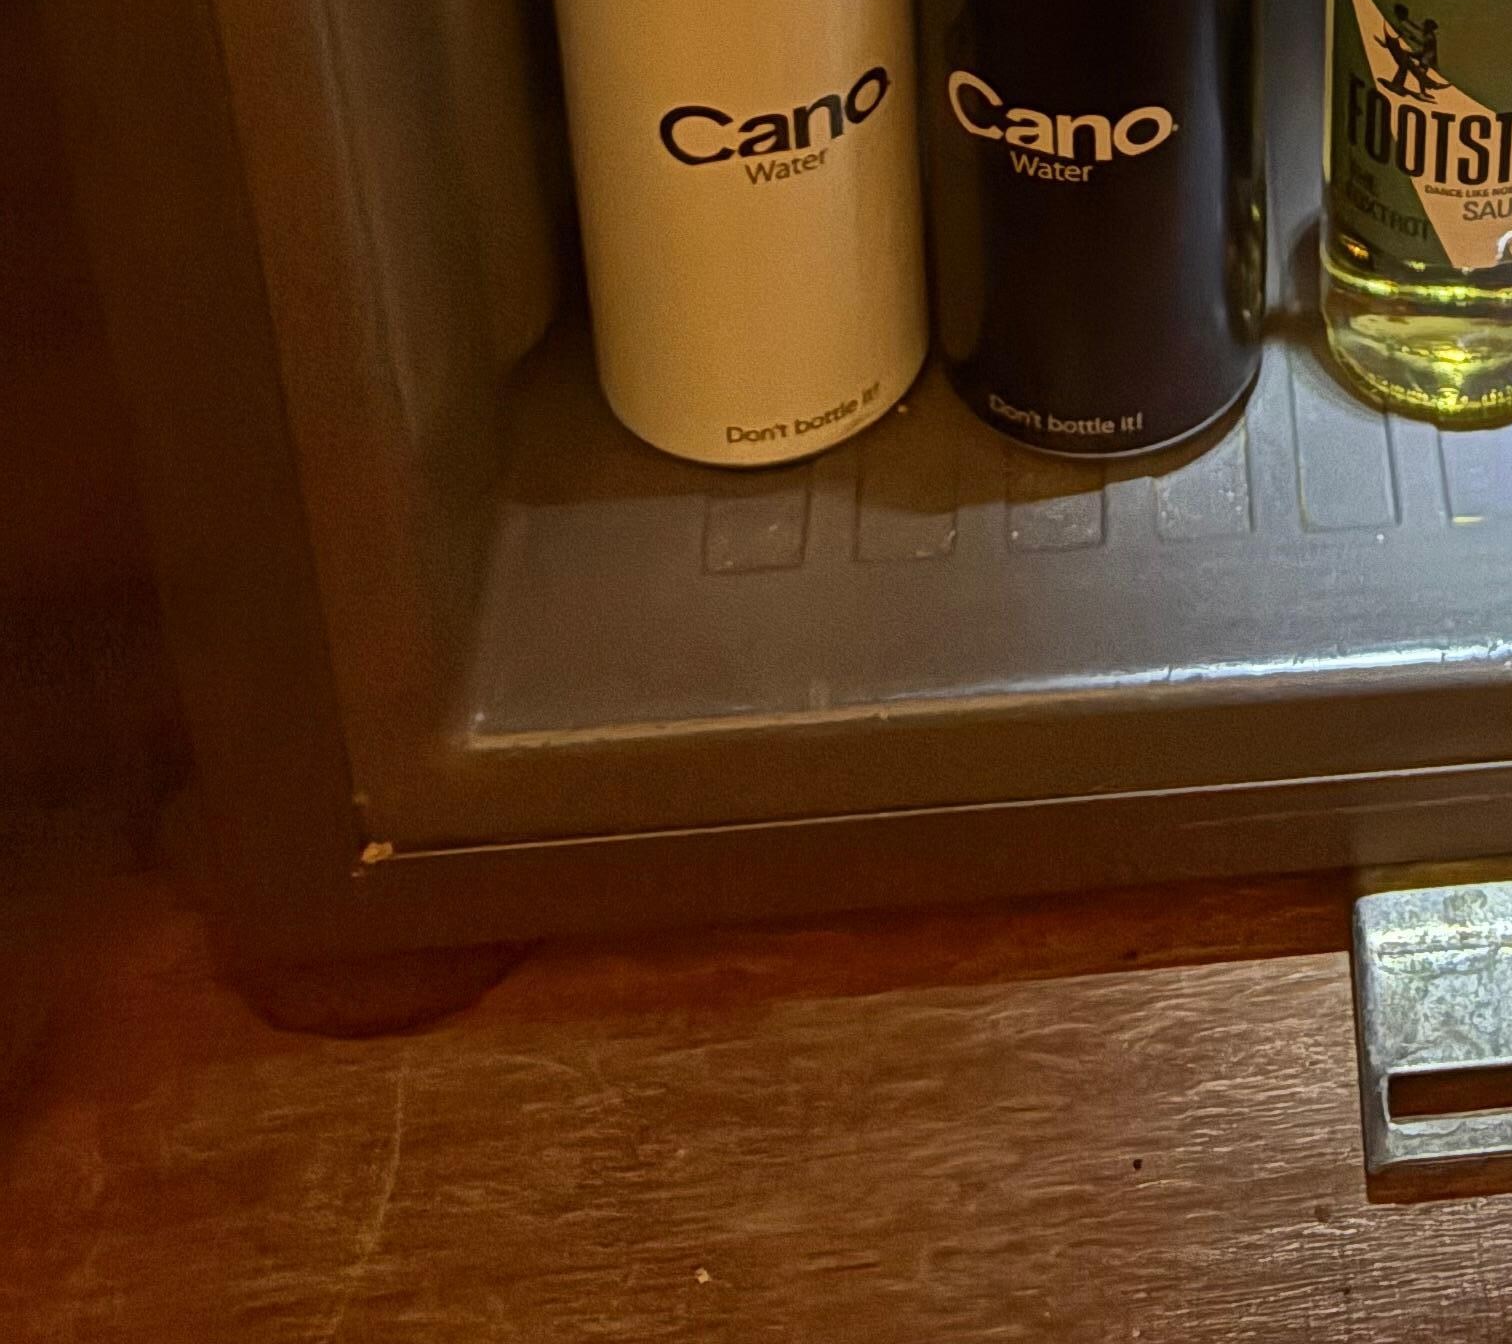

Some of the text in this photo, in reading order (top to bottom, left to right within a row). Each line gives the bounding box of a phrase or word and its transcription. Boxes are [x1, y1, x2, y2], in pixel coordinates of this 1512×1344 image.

[659, 66, 890, 166] Cano
[948, 70, 1174, 161] Cano
[744, 148, 829, 185] Water
[1009, 150, 1094, 182] Water
[1048, 414, 1115, 435] bottle
